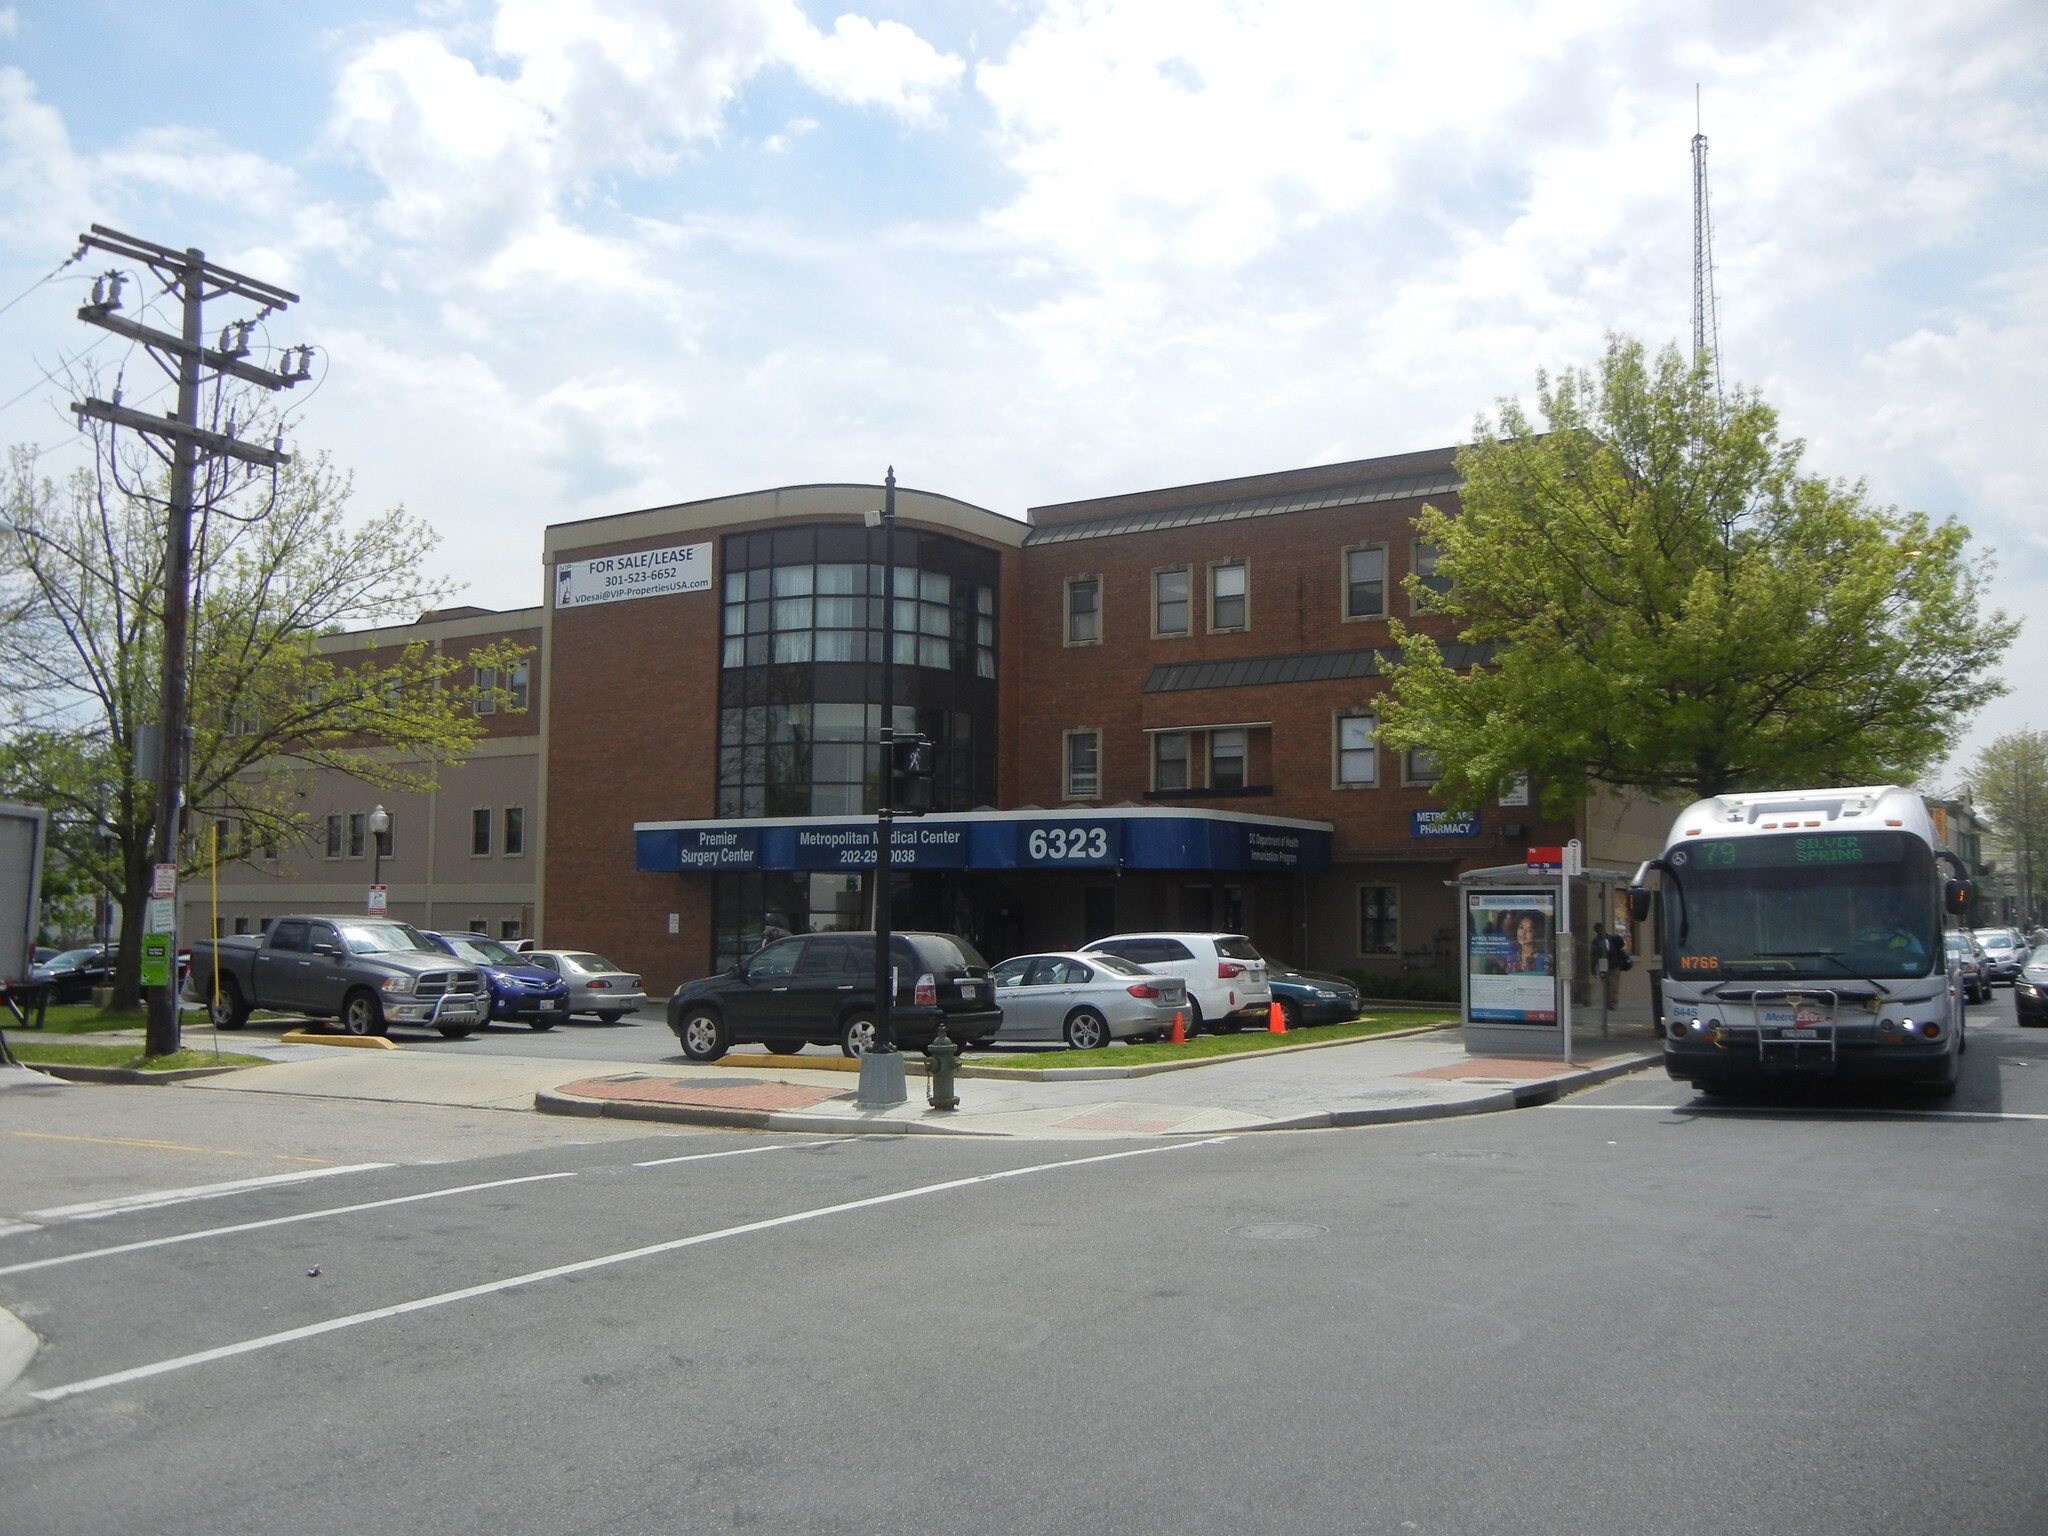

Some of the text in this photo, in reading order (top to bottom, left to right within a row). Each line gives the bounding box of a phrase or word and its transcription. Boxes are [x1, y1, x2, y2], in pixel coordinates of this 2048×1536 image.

[589, 548, 694, 574] FOR SALE/LEASE
[605, 567, 677, 587] 301-523-6652
[575, 579, 709, 603] VDesai@VIP-PropertiesUSA.com
[1420, 823, 1471, 834] PHARMACY
[699, 831, 738, 846] Premier
[799, 830, 960, 848] Metropolitan Mdical Center
[1029, 827, 1108, 860] 6323
[681, 848, 754, 866] Surgery Center
[1702, 836, 1859, 865] 79 SILVER
[1796, 849, 1864, 862] SPRING
[1680, 956, 1719, 969] N766
[1673, 1007, 1698, 1017] 6445
